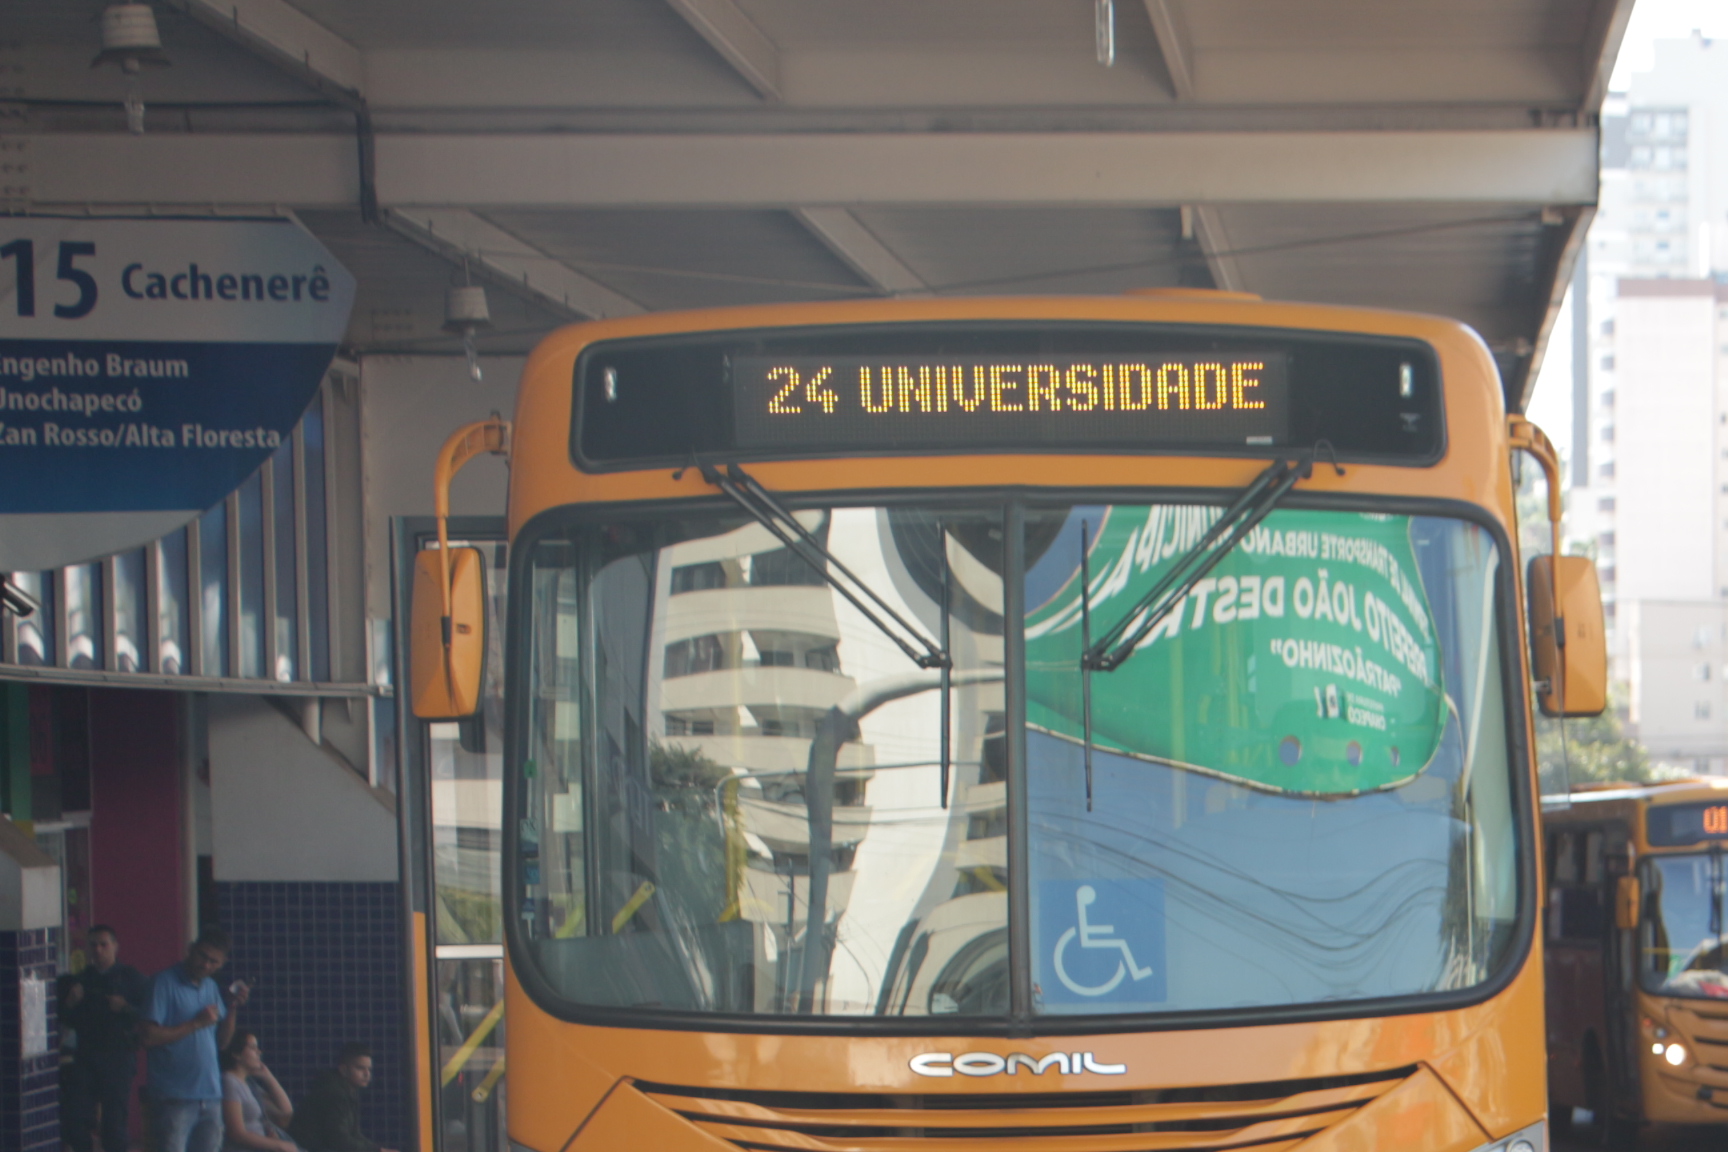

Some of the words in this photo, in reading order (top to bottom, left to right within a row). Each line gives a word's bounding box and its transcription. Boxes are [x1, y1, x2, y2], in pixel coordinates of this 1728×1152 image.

[0, 239, 98, 320] 15
[121, 262, 330, 301] Cachenerê
[0, 353, 99, 381] ngenho
[106, 354, 188, 378] Braum
[768, 366, 838, 414] 24
[860, 362, 1265, 413] UNIVERSIDADE
[182, 424, 281, 448] Floresta
[909, 1052, 1127, 1077] COMIL
